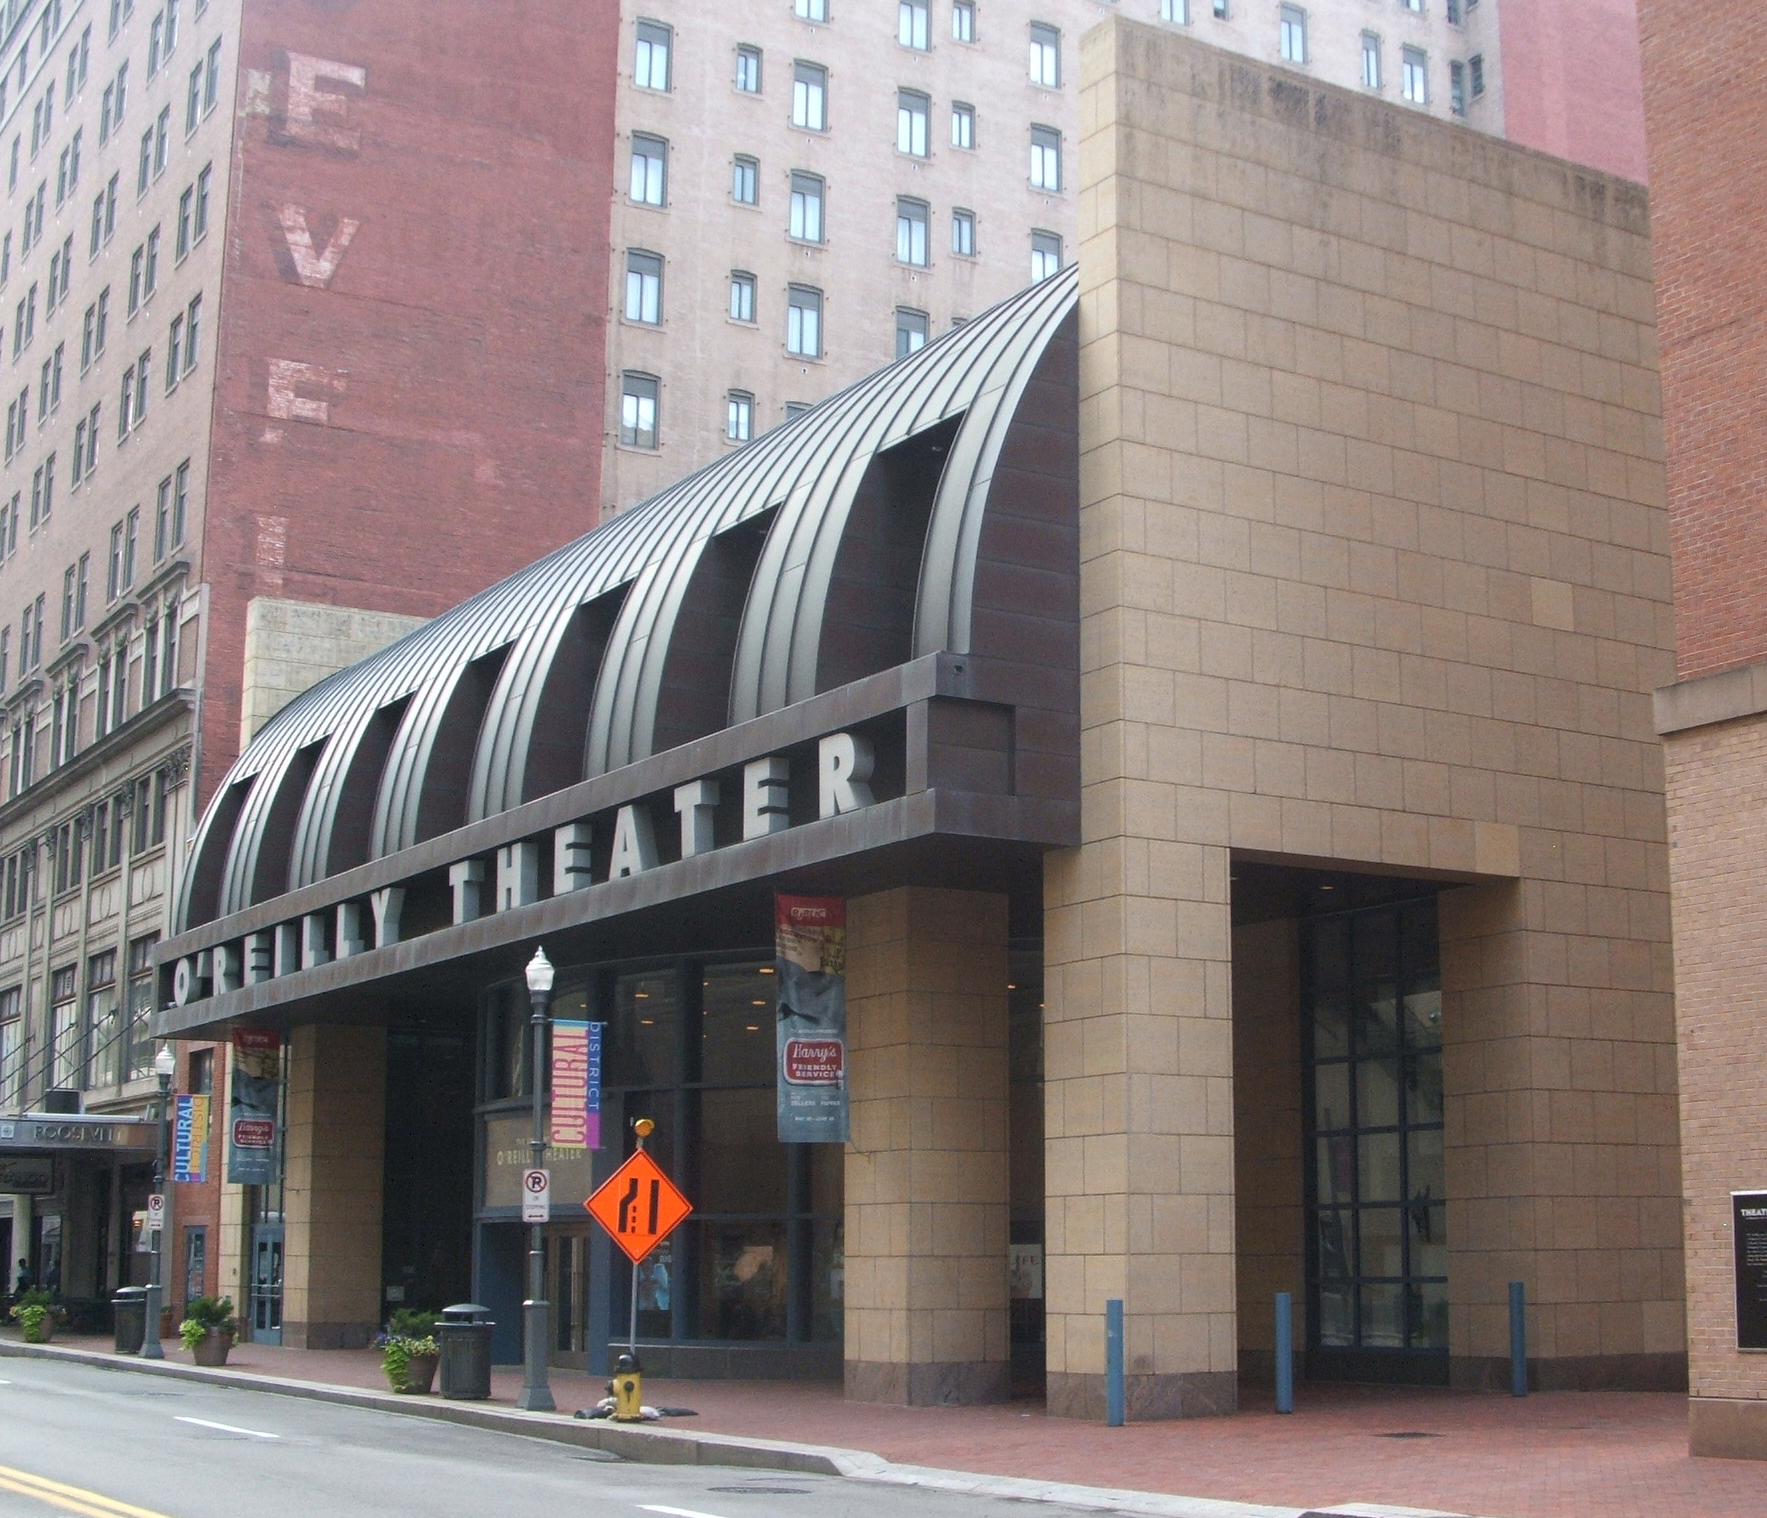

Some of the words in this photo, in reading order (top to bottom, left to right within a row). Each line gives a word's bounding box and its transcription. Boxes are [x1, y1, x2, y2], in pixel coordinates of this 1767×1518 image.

[173, 887, 405, 1007] O'REILLY
[449, 732, 875, 925] THEATER
[551, 1031, 588, 1144] CULTURAL
[588, 1021, 601, 1111] DISTRICT
[795, 1070, 835, 1078] SERVICE
[174, 1098, 194, 1182] CULTURAL
